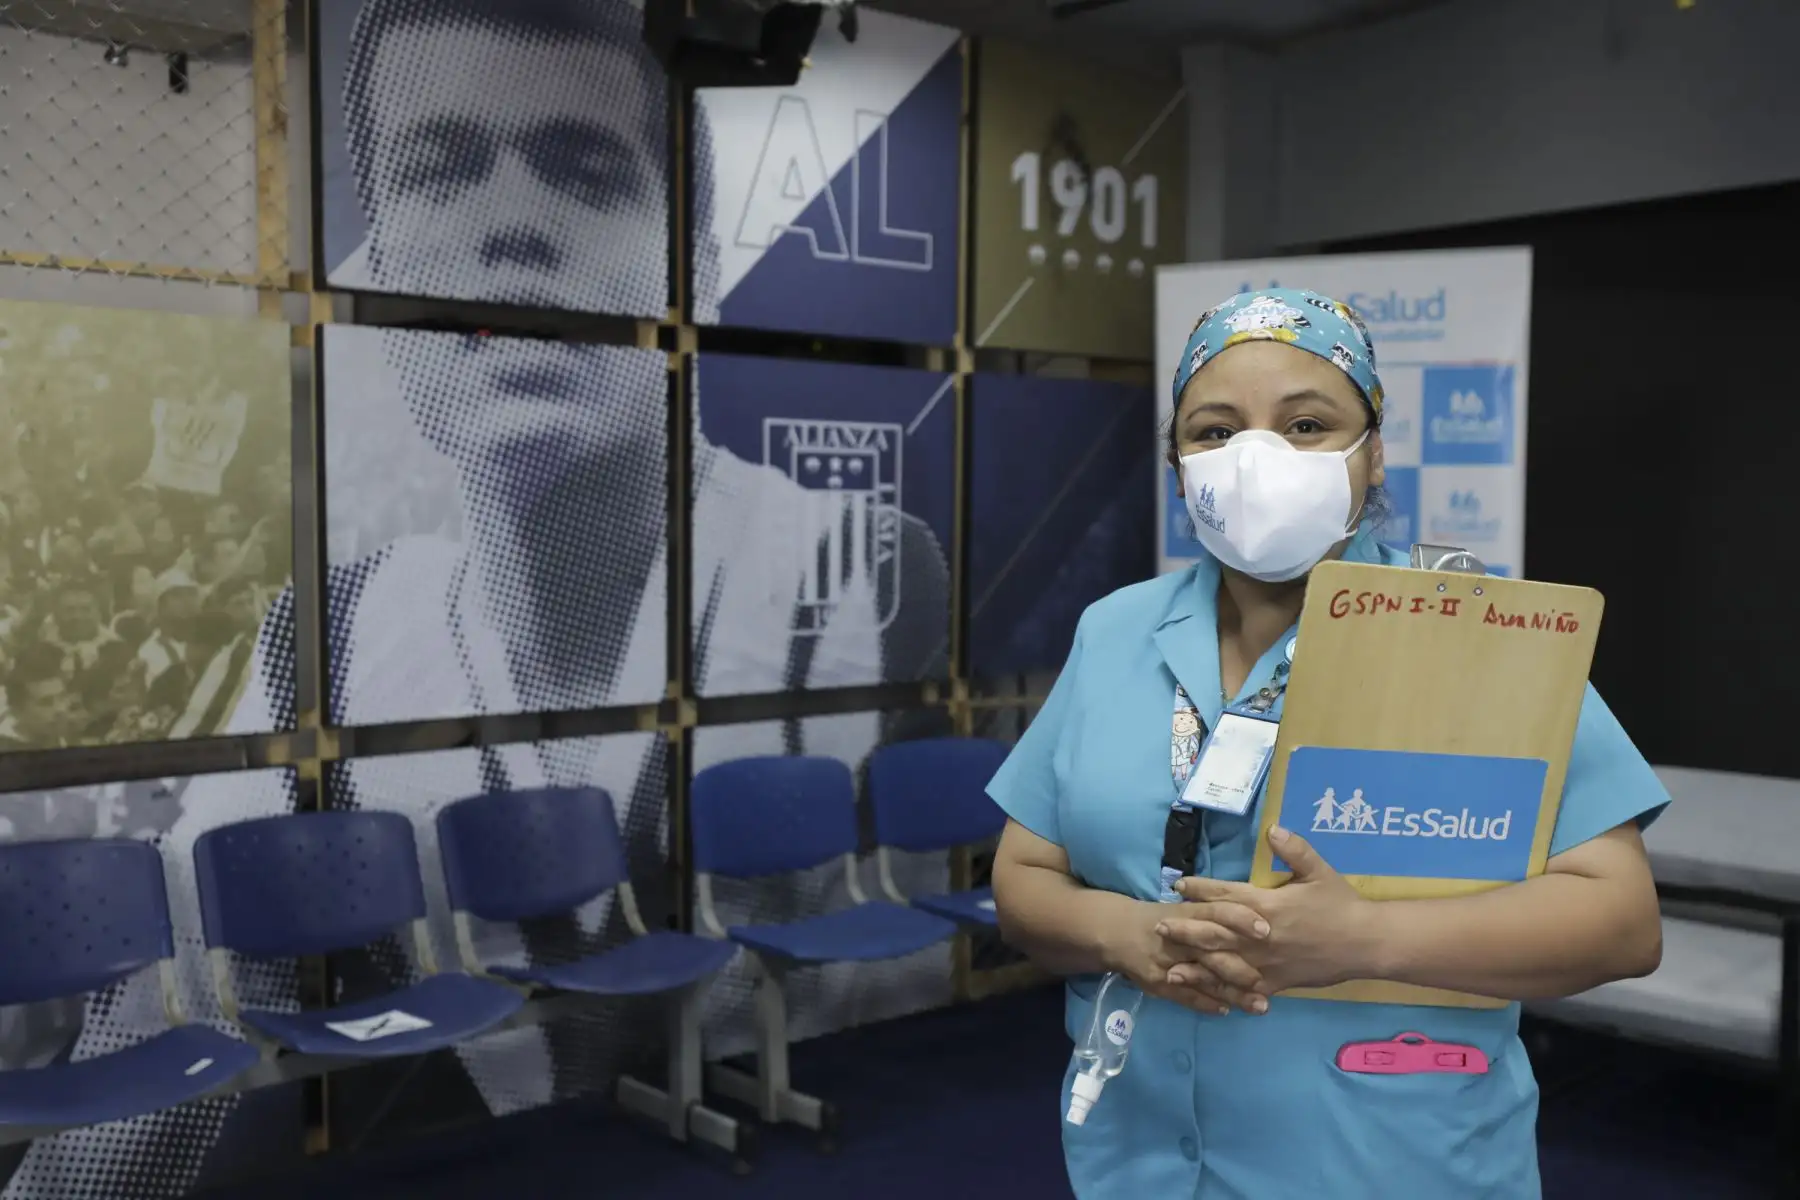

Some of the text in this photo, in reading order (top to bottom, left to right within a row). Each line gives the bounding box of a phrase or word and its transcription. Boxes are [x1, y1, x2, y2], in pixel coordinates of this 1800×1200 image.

[734, 95, 933, 271] AL
[1011, 151, 1159, 249] 1901
[1347, 286, 1446, 323] Salud
[784, 424, 888, 451] ALIANZA
[1195, 503, 1226, 534] EsSalud
[1329, 588, 1402, 619] GSPN
[1381, 806, 1512, 841] EsSalud
